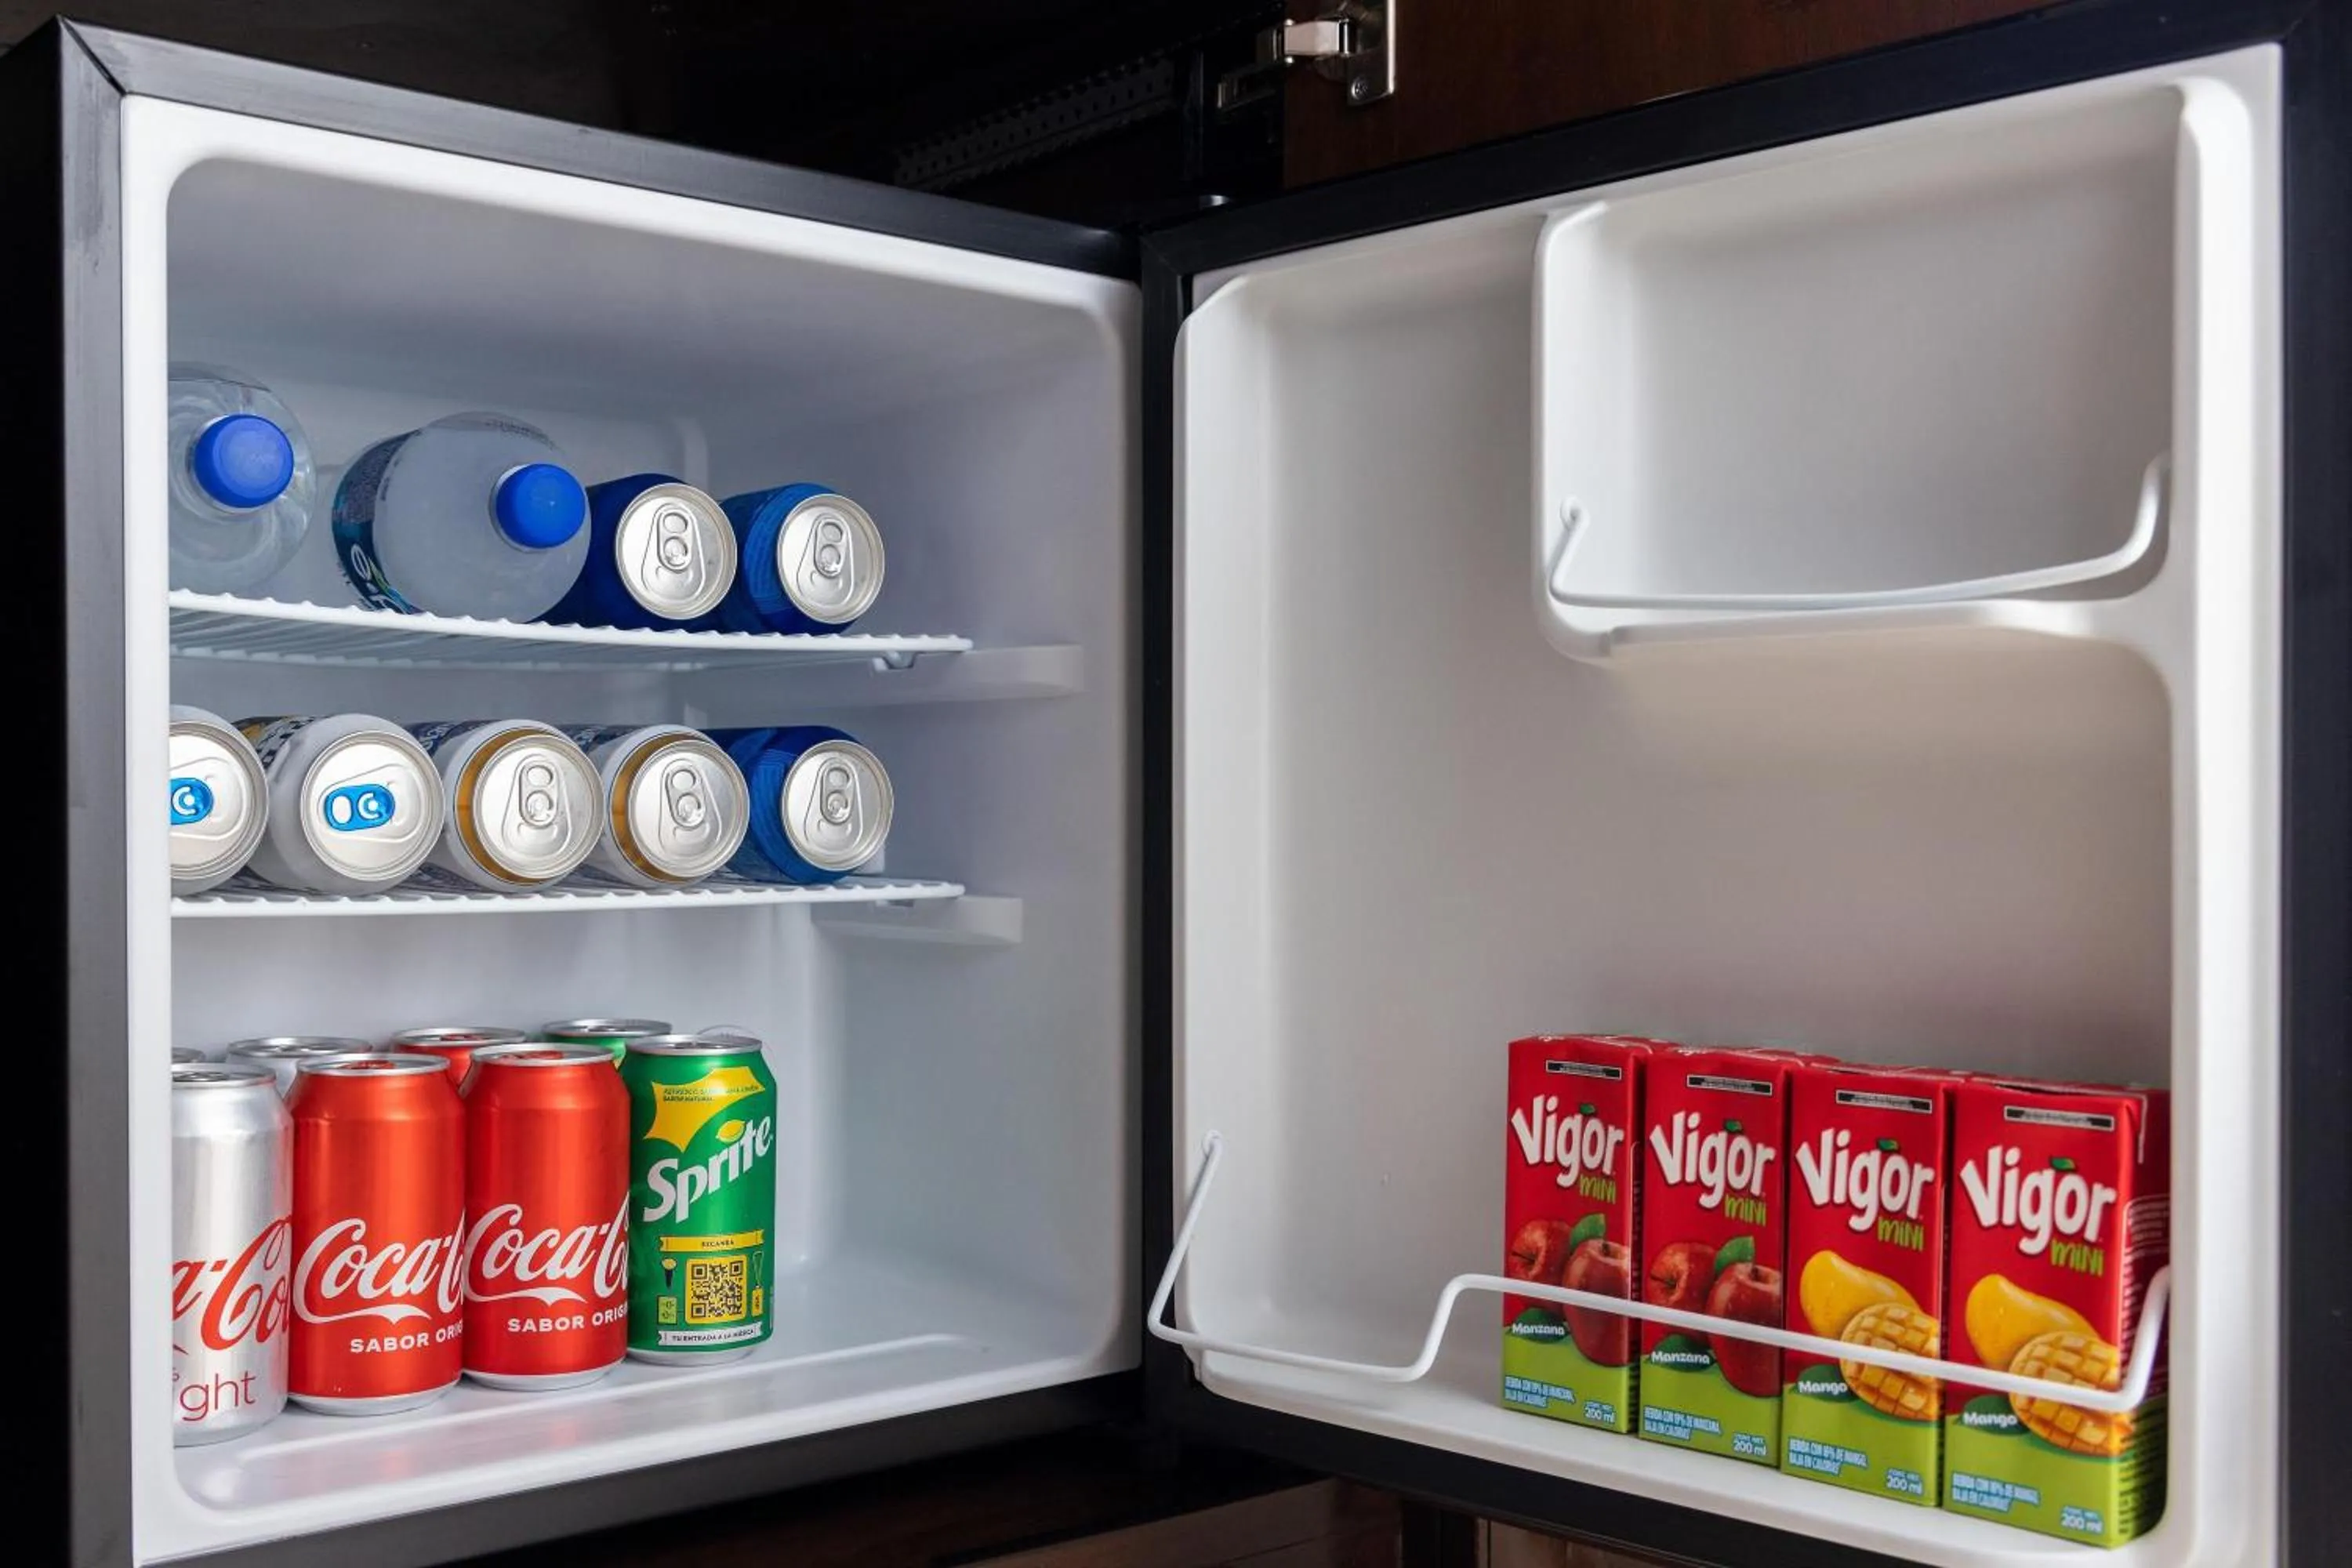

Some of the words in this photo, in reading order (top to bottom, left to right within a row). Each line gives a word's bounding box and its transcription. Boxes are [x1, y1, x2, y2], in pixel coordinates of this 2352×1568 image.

[1511, 1094, 1624, 1189] Vigor
[642, 1116, 772, 1223] Sprite
[1650, 1112, 1775, 1209] Vigor
[1795, 1127, 1934, 1232] Vigor
[1960, 1145, 2117, 1255] Vigor
[507, 1316, 584, 1332] SABOR
[1512, 1323, 1565, 1335] Manzana
[350, 1333, 430, 1352] SABOR
[1651, 1351, 1710, 1365] Manzana
[173, 1370, 256, 1421] ght
[1798, 1381, 1848, 1395] Mango
[1585, 1408, 1602, 1420] 200
[1603, 1410, 1615, 1423] ml
[1962, 1412, 2018, 1427] Mango
[1734, 1441, 1753, 1454] 200
[1754, 1445, 1766, 1456] ml
[1887, 1476, 1907, 1490] 200
[1908, 1481, 1922, 1494] ml
[2061, 1515, 2085, 1530] 200
[2086, 1520, 2103, 1533] ml
